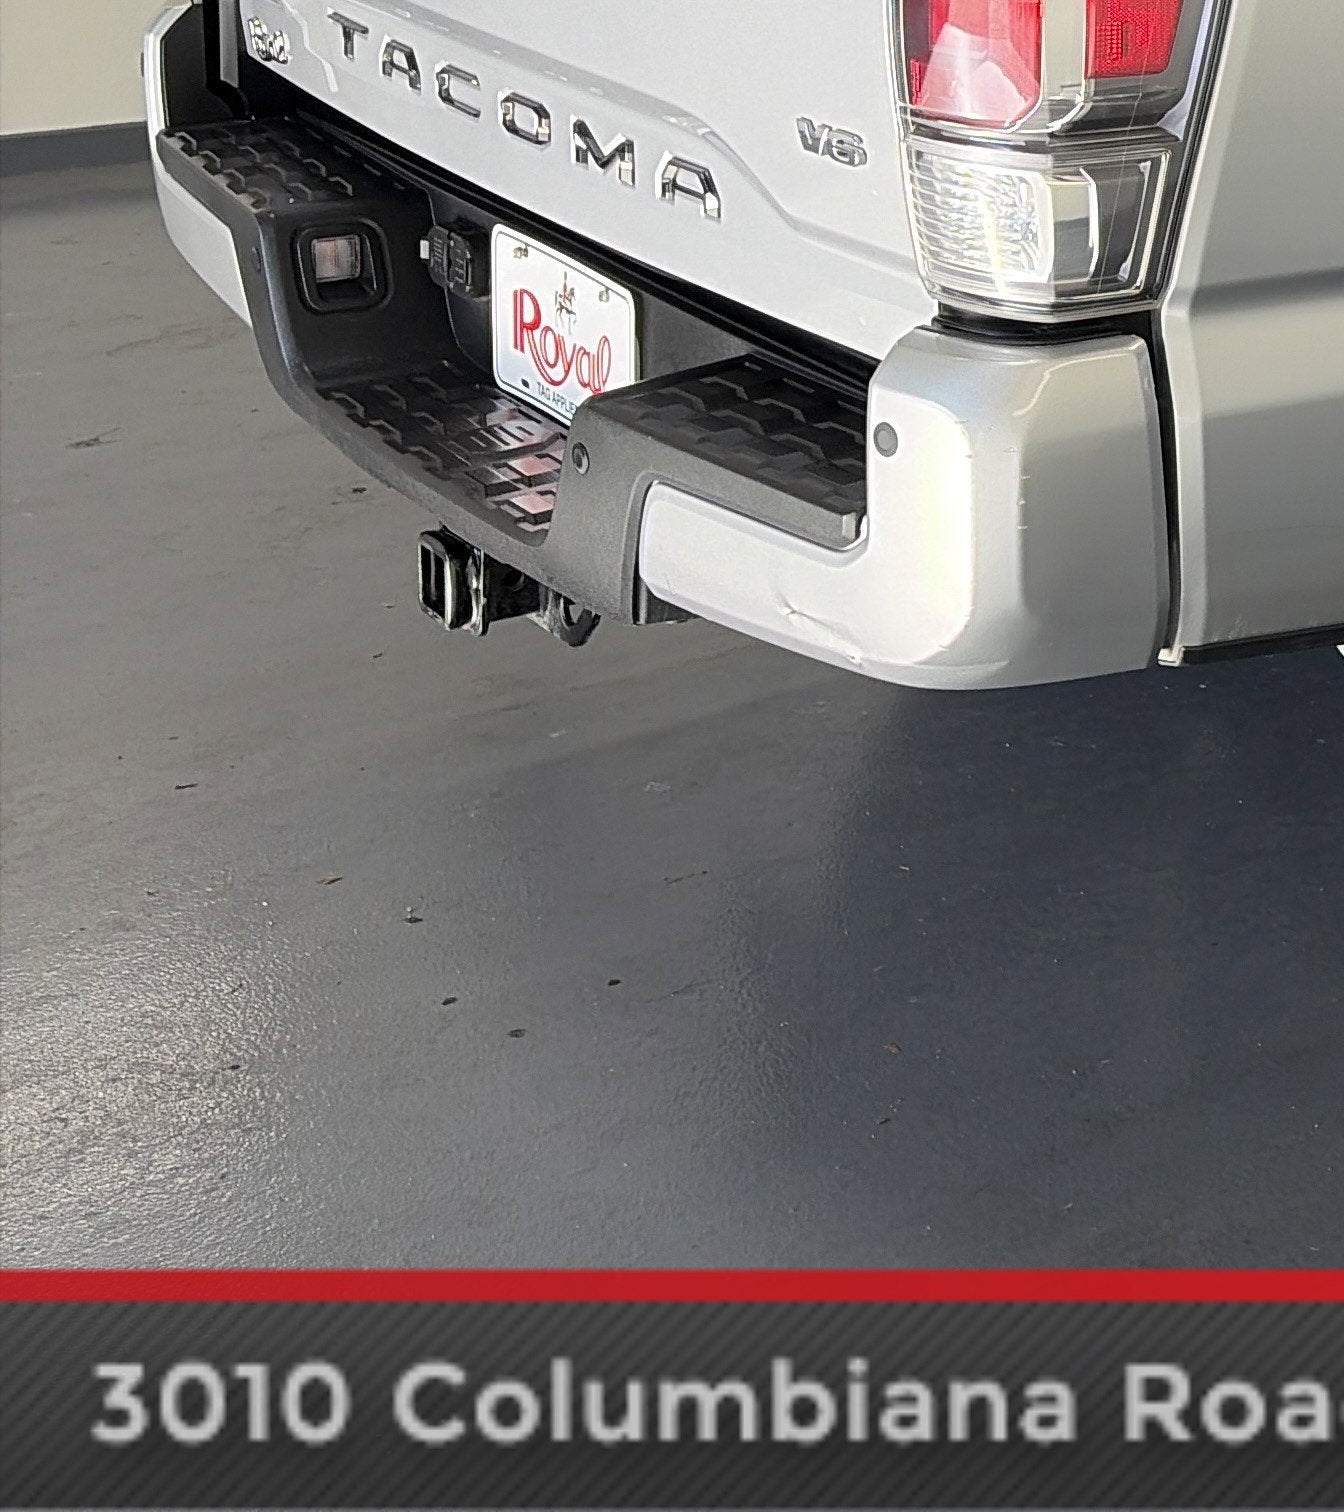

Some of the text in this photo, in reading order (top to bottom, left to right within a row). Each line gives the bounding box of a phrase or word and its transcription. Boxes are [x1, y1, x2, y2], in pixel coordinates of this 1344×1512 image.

[326, 8, 722, 219] TACOMA
[796, 116, 868, 167] V6
[513, 288, 611, 395] Royal
